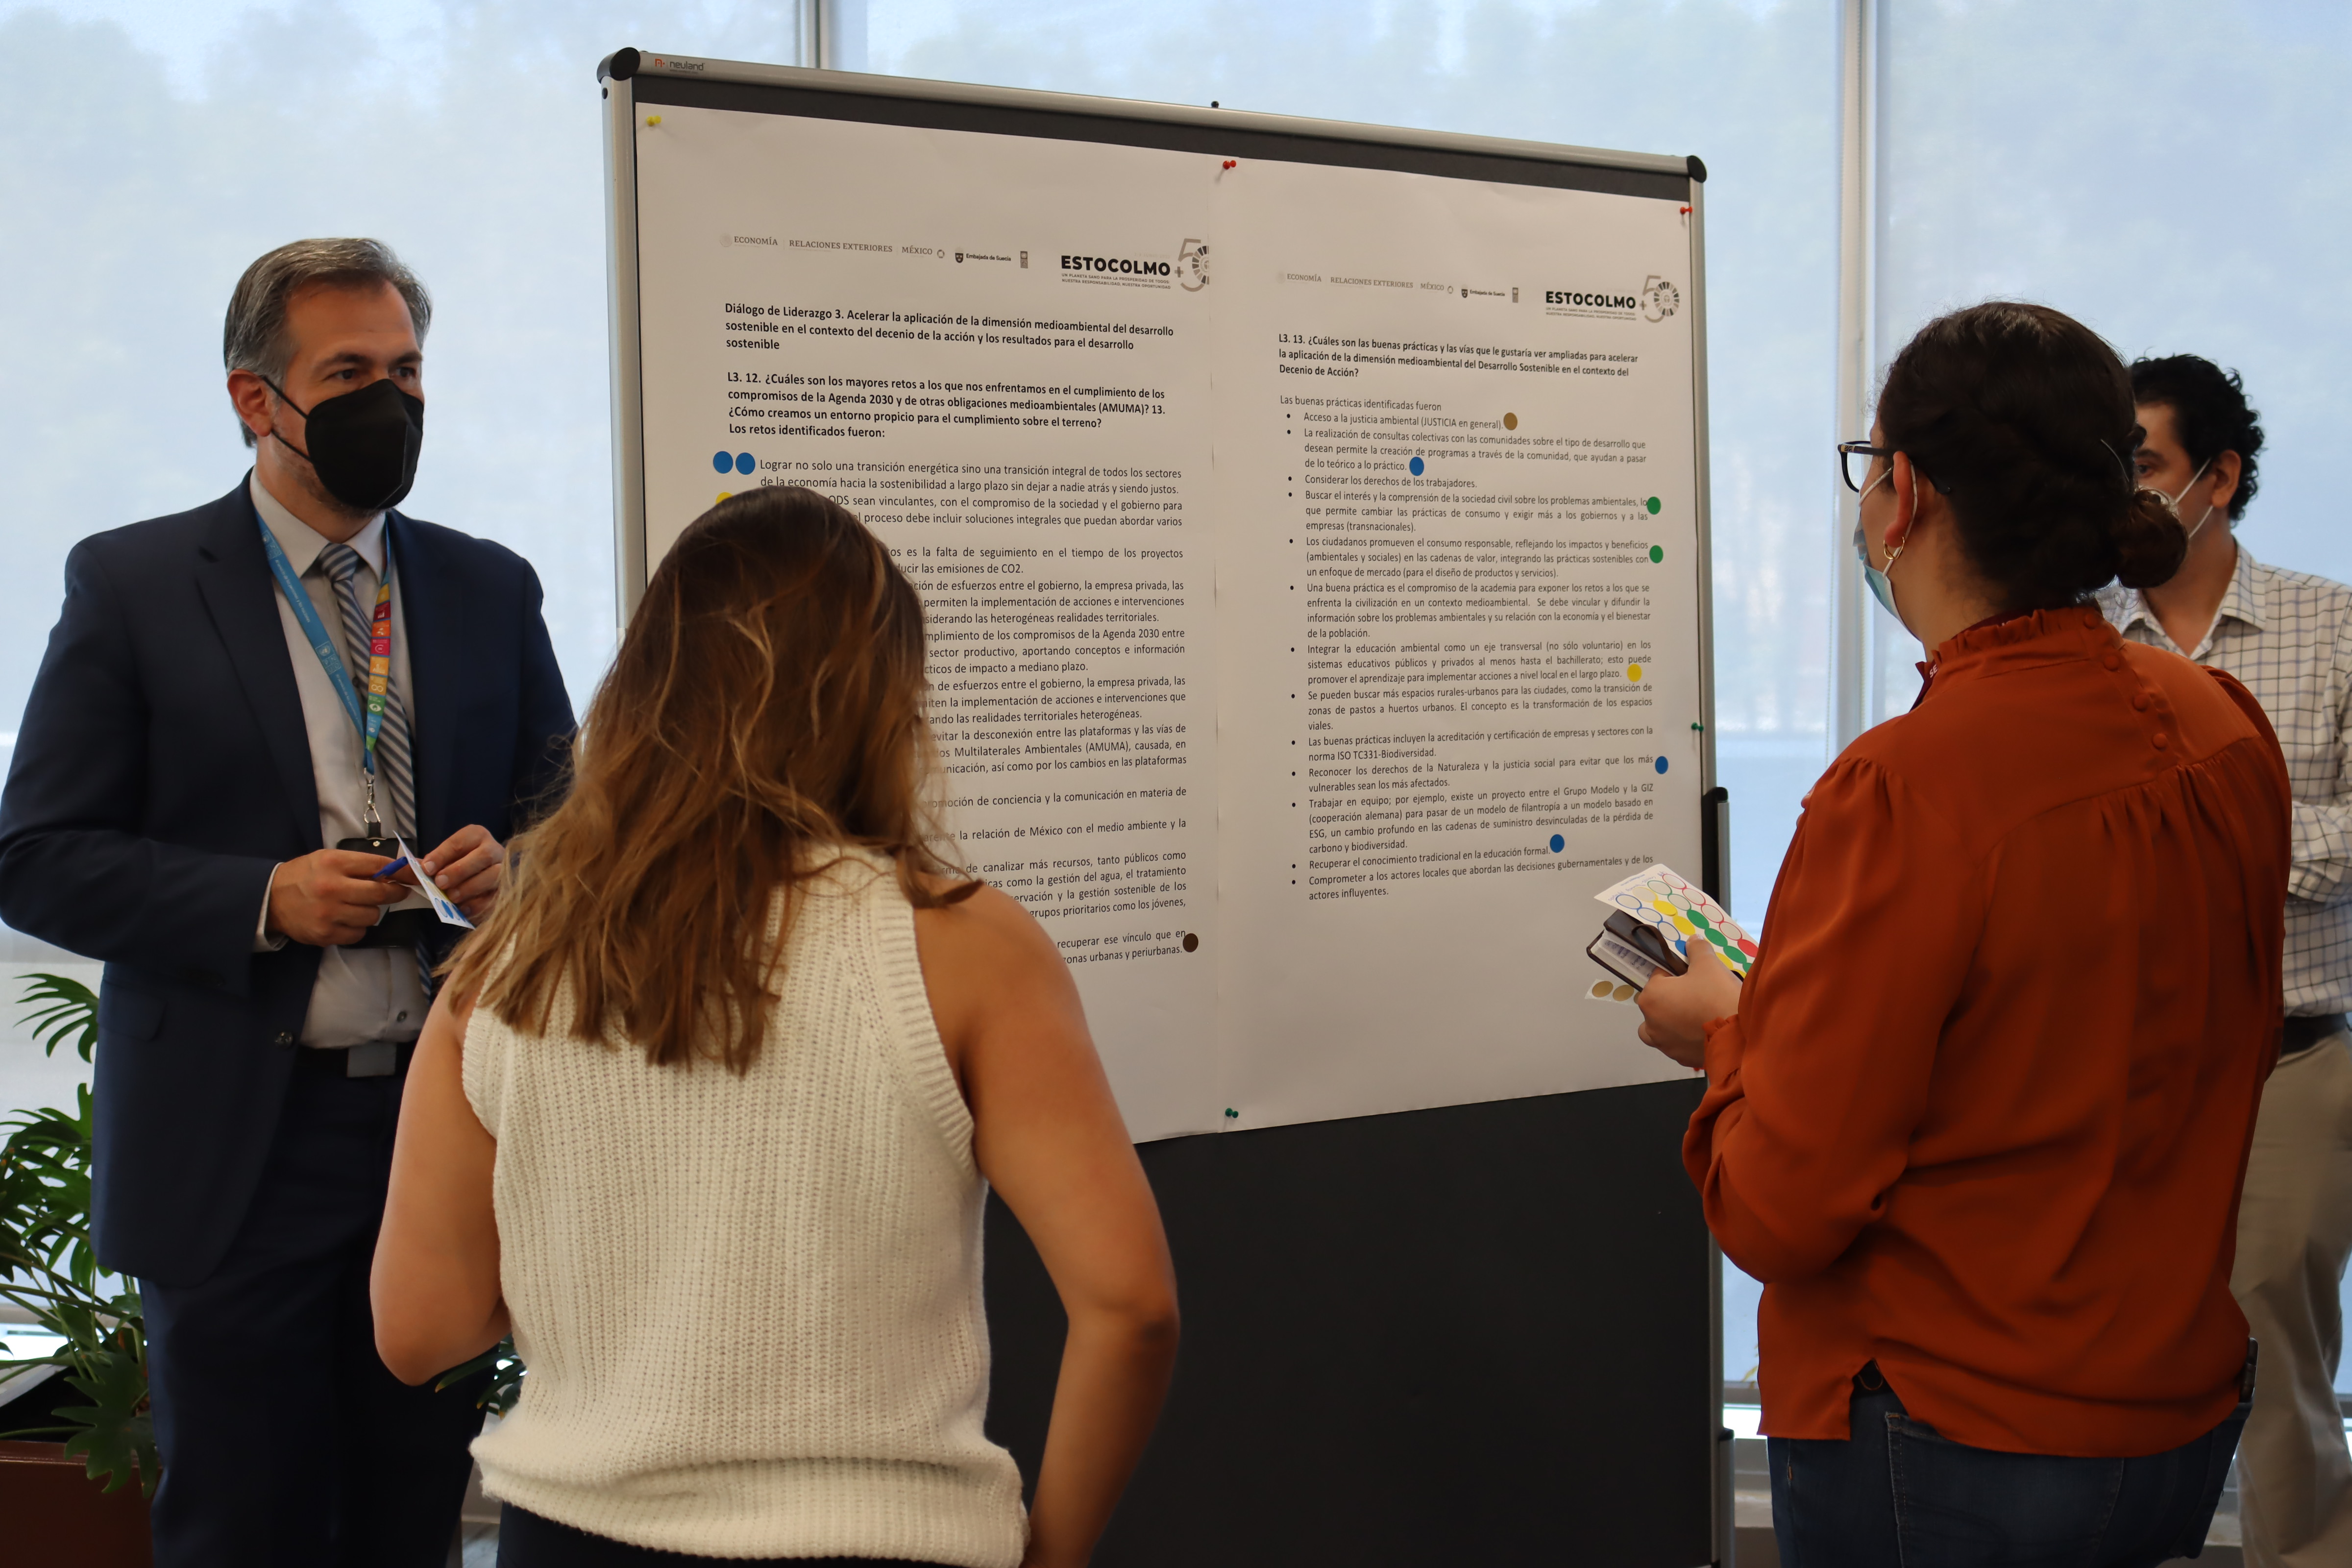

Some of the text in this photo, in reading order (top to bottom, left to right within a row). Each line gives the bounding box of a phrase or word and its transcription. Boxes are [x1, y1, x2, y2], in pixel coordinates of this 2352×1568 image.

[669, 61, 704, 71] neuland
[734, 236, 778, 246] ECONOMÍA
[789, 240, 893, 252] RELACIONES EXTERIORES
[902, 245, 933, 255] MÉXICO
[1061, 255, 1171, 276] ESTOCOLMO
[1287, 273, 1322, 282] ECONOMÍA
[1330, 276, 1414, 289] RELACIONES EXTERIORES
[1420, 282, 1445, 291] MÉXICO
[1546, 291, 1636, 309] ESTOCOLMO
[725, 303, 1174, 336] Diálogo de Liderazgo 3. Acelerar la aplicación de la dimensión medioambiental del desarrollo
[726, 338, 780, 350] sostenible
[1279, 333, 1291, 343] L3.
[1293, 334, 1305, 344] 13.
[1308, 336, 1339, 346] ¿Cuáles
[1341, 339, 1356, 347] son
[1358, 338, 1370, 348] las
[1372, 339, 1401, 350] buenas
[1402, 341, 1438, 352] prácticas
[1440, 345, 1445, 354] y
[1446, 343, 1457, 353] las
[1459, 344, 1474, 354] vías
[1476, 347, 1491, 357] que
[1493, 346, 1499, 356] le
[1501, 348, 1532, 358] gustaría
[1548, 350, 1588, 361] ampliadas
[1590, 354, 1606, 362] para
[1608, 353, 1638, 363] acelerar
[1279, 364, 1359, 377] Decenio de Acción?
[728, 390, 1165, 416] compromisos de la Agenda 2030 y de otras obligaciones medioambientales (AMUMA)? 13.
[1303, 412, 1332, 422] Acceso
[1341, 413, 1348, 423] la
[1349, 414, 1378, 425] justicia
[1380, 415, 1419, 425] ambiental
[1421, 416, 1457, 428] (JUSTICIA
[1470, 420, 1503, 432] general).
[729, 423, 885, 438] Los retos identificados fueron:
[1305, 474, 1477, 490] Considerar los derechos de los trabajadores.
[1306, 521, 1416, 533] empresas (transnacionales).
[929, 648, 959, 658] sector
[964, 646, 1018, 659] productivo,
[1022, 645, 1071, 658] aportando
[1075, 646, 1121, 657] conceptos
[1134, 643, 1185, 654] información
[955, 745, 1021, 757] Multilaterales
[1024, 742, 1082, 755] Ambientales
[1085, 740, 1131, 754] (AMUMA),
[1135, 739, 1172, 751] causada,
[1309, 747, 1436, 761] norma ISO TC331-Biodiversidad.
[1308, 798, 1343, 809] Trabajar
[1361, 796, 1391, 808] equipo;
[1395, 796, 1409, 806] por
[1413, 792, 1447, 805] ejemplo,
[1451, 792, 1474, 801] existe
[1492, 790, 1525, 801] proyecto
[1529, 789, 1549, 798] entre
[1553, 787, 1560, 796] el
[1564, 787, 1587, 797] Grupo
[1591, 784, 1620, 794] Modelo
[1623, 786, 1628, 795] y
[1631, 784, 1638, 793] la
[1641, 783, 1653, 792] GIZ
[960, 830, 968, 840] la
[972, 828, 1010, 839] relación
[1014, 827, 1026, 837] de
[1029, 826, 1063, 836] México
[1066, 826, 1082, 834] con
[1086, 823, 1094, 833] el
[1097, 822, 1124, 833] medio
[1127, 820, 1167, 831] ambiente
[1170, 821, 1176, 831] y
[1178, 818, 1186, 828] la
[1309, 860, 1351, 870] Recuperar
[1352, 857, 1360, 867] el
[1362, 855, 1417, 866] conocimiento
[1419, 851, 1461, 862] tradicional
[1474, 850, 1481, 859] la
[1483, 847, 1522, 858] educación
[1523, 846, 1551, 857] formal.
[1309, 887, 1389, 900] actores influyentes.
[1063, 903, 1110, 918] prioritarios
[1113, 903, 1136, 912] como
[1138, 899, 1150, 909] los
[1151, 898, 1186, 911] jóvenes,
[1089, 951, 1123, 962] urbanas
[1125, 951, 1130, 961] y
[1132, 945, 1183, 960] periurbanas.
